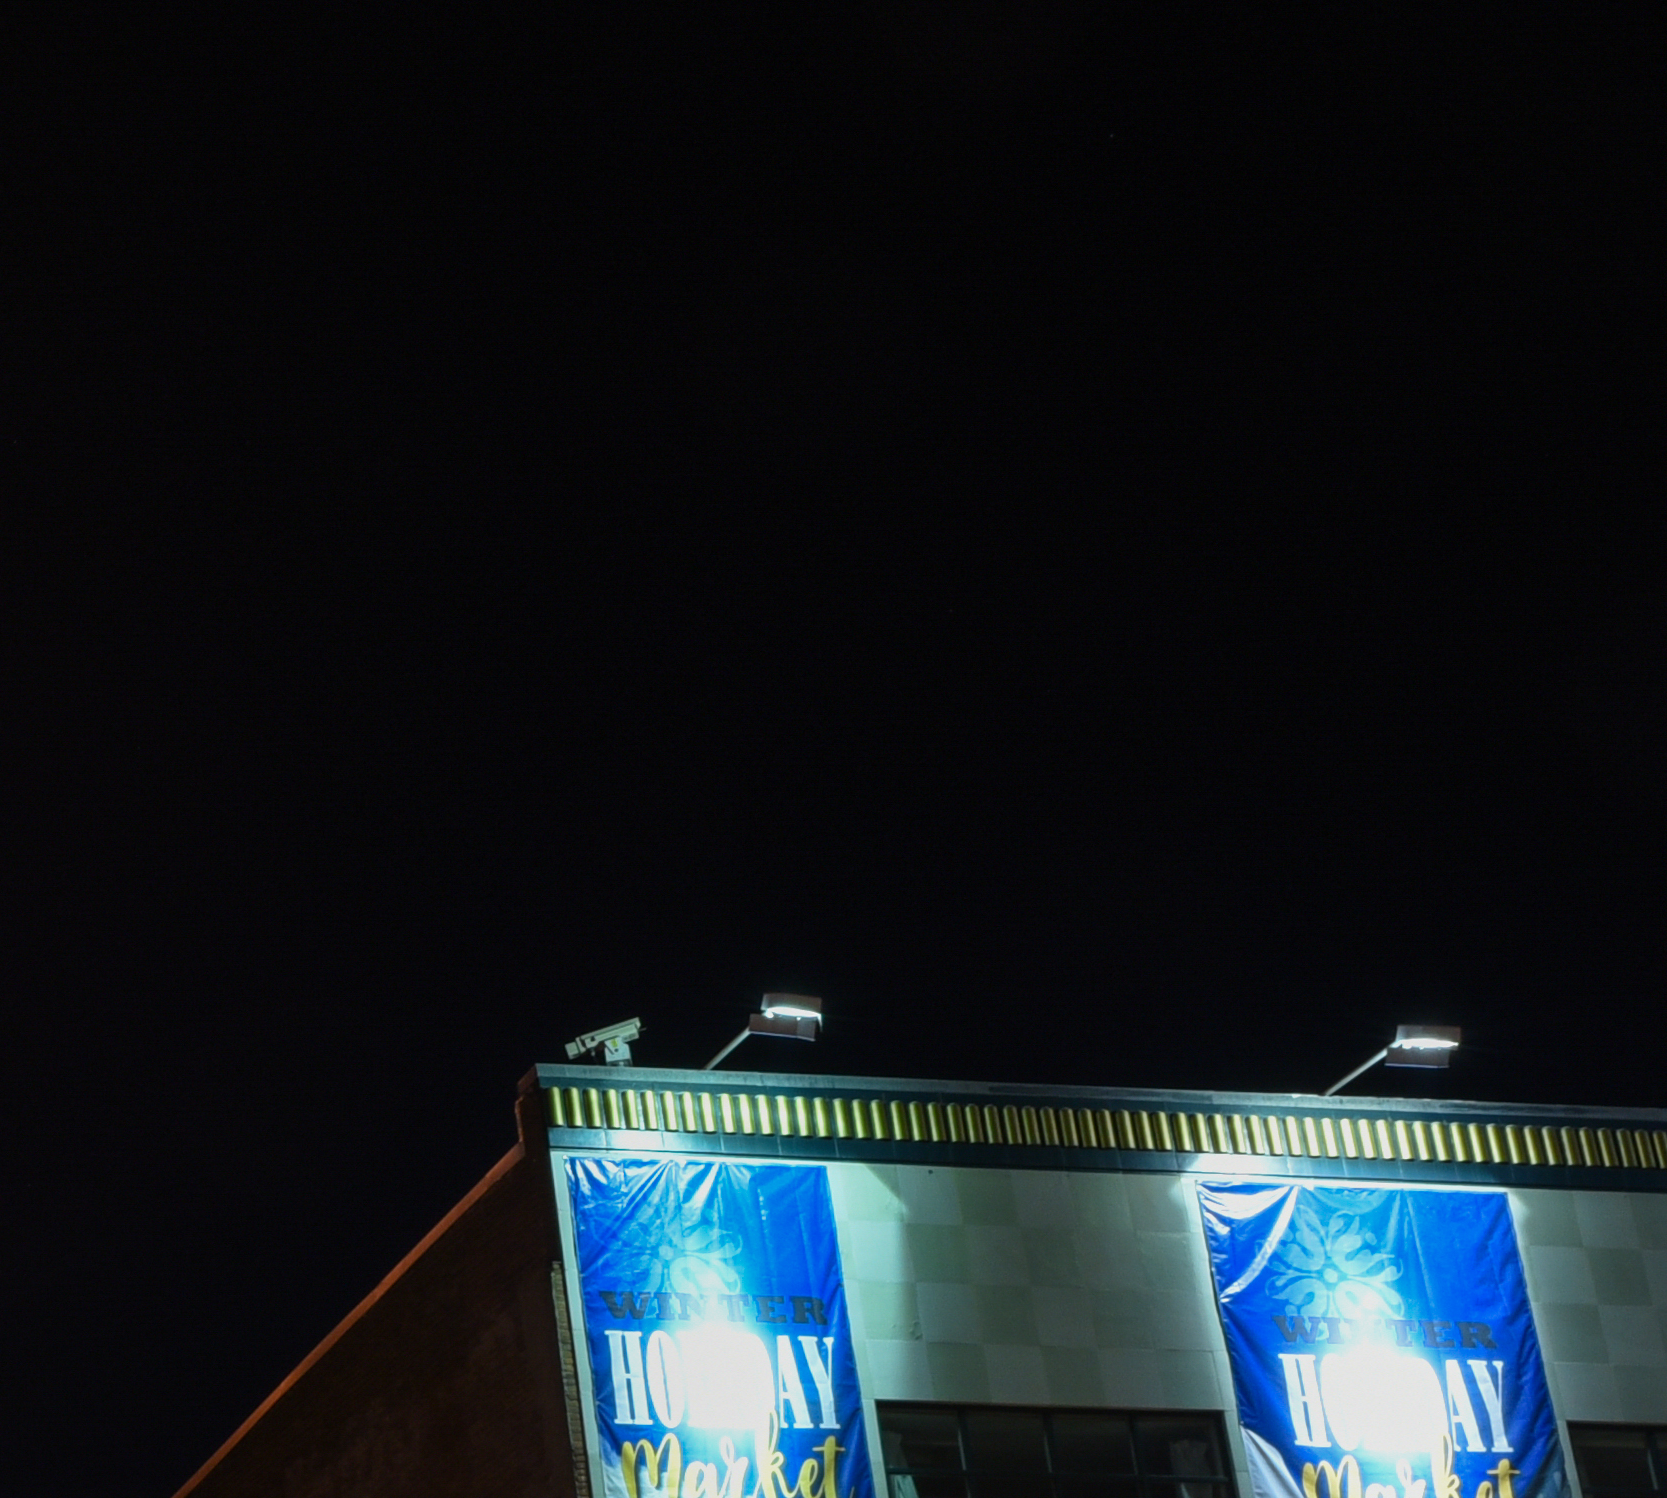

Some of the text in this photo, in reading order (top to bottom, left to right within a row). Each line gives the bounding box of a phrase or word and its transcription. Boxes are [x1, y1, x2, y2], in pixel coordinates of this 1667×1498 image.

[604, 1329, 842, 1430] HOAY
[1271, 1314, 1498, 1350] WITER
[1278, 1352, 1515, 1453] HOAY
